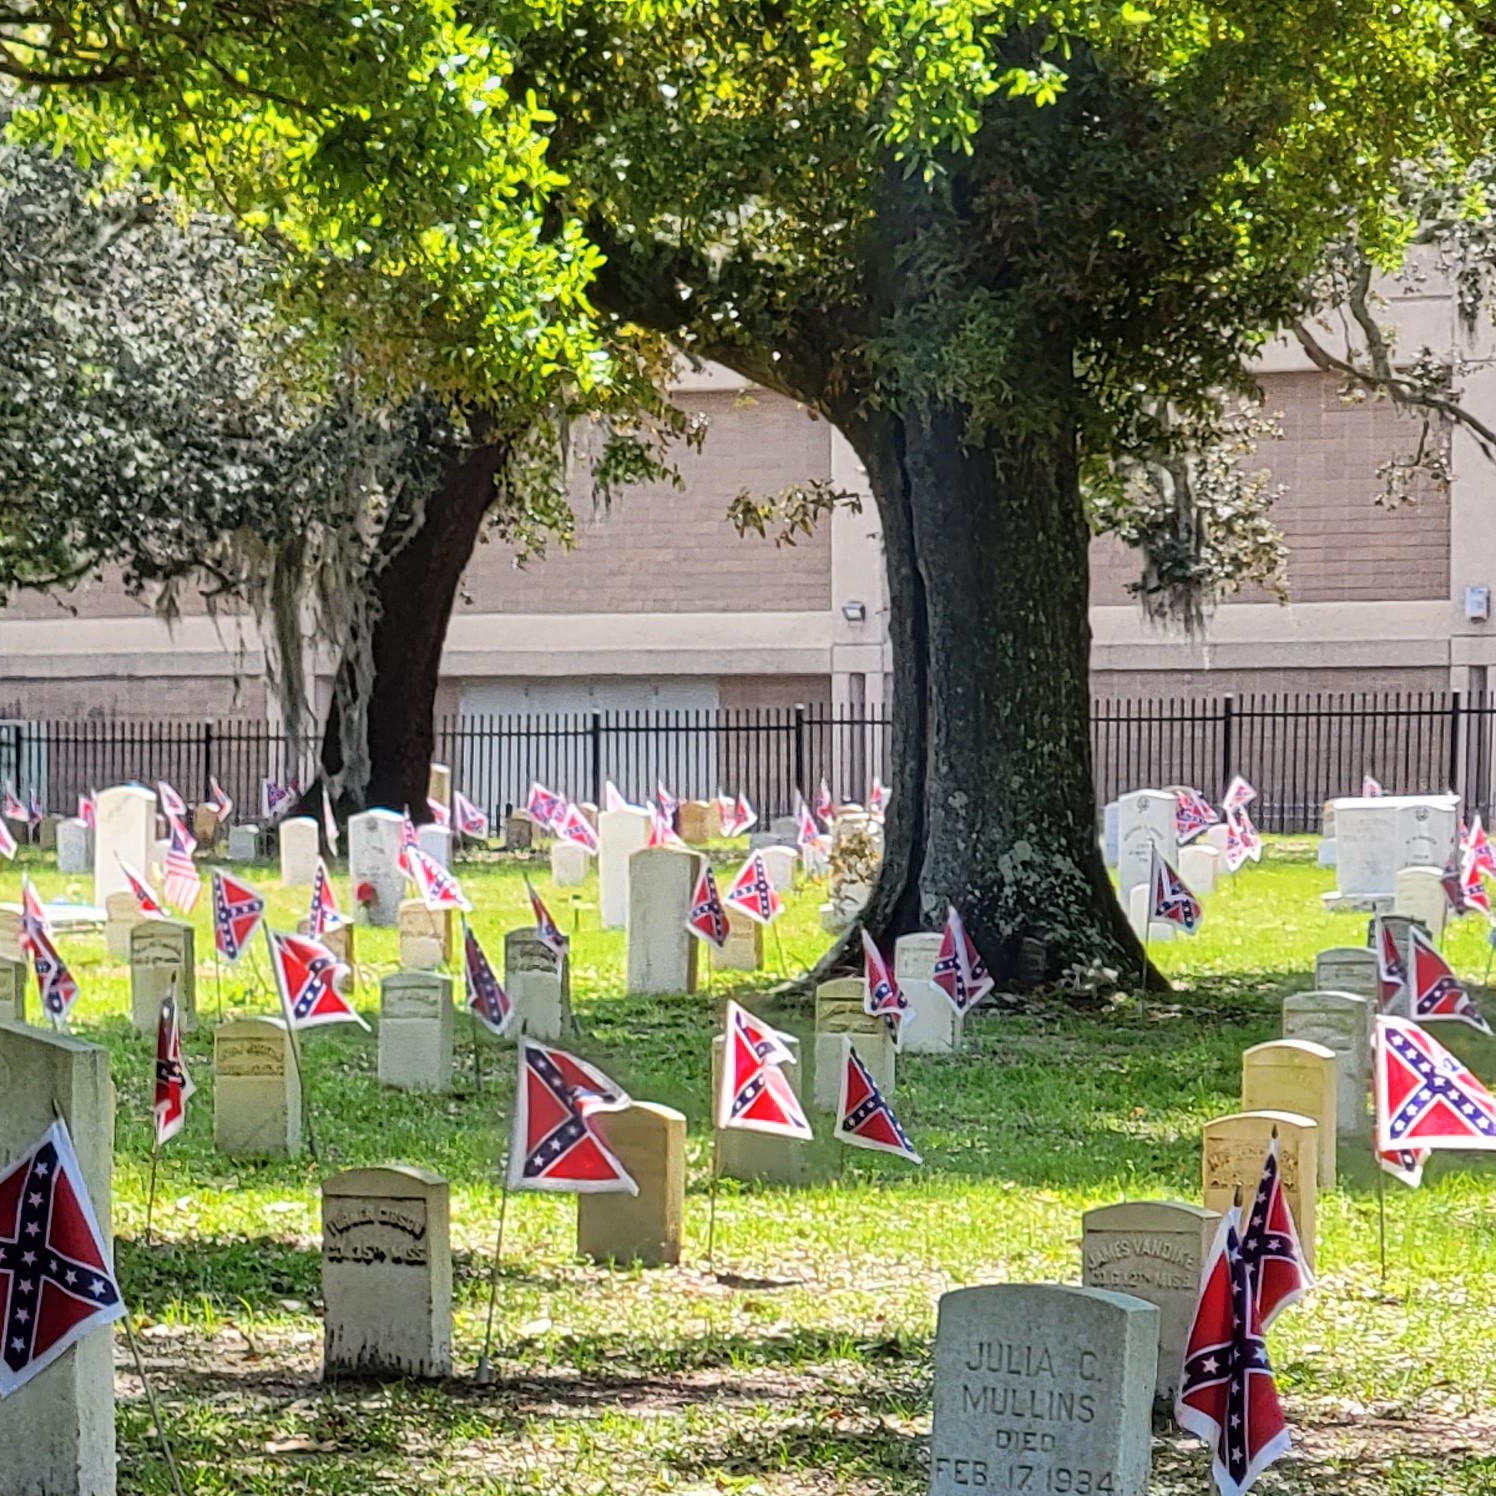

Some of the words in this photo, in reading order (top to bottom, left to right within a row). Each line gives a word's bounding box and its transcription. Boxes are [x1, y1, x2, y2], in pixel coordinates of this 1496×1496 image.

[1087, 1239, 1131, 1271] JAMES
[965, 1340, 1055, 1379] JULIA
[961, 1384, 1096, 1424] MULLINS
[995, 1429, 1056, 1452] DIED
[1045, 1467, 1115, 1496] 1934
